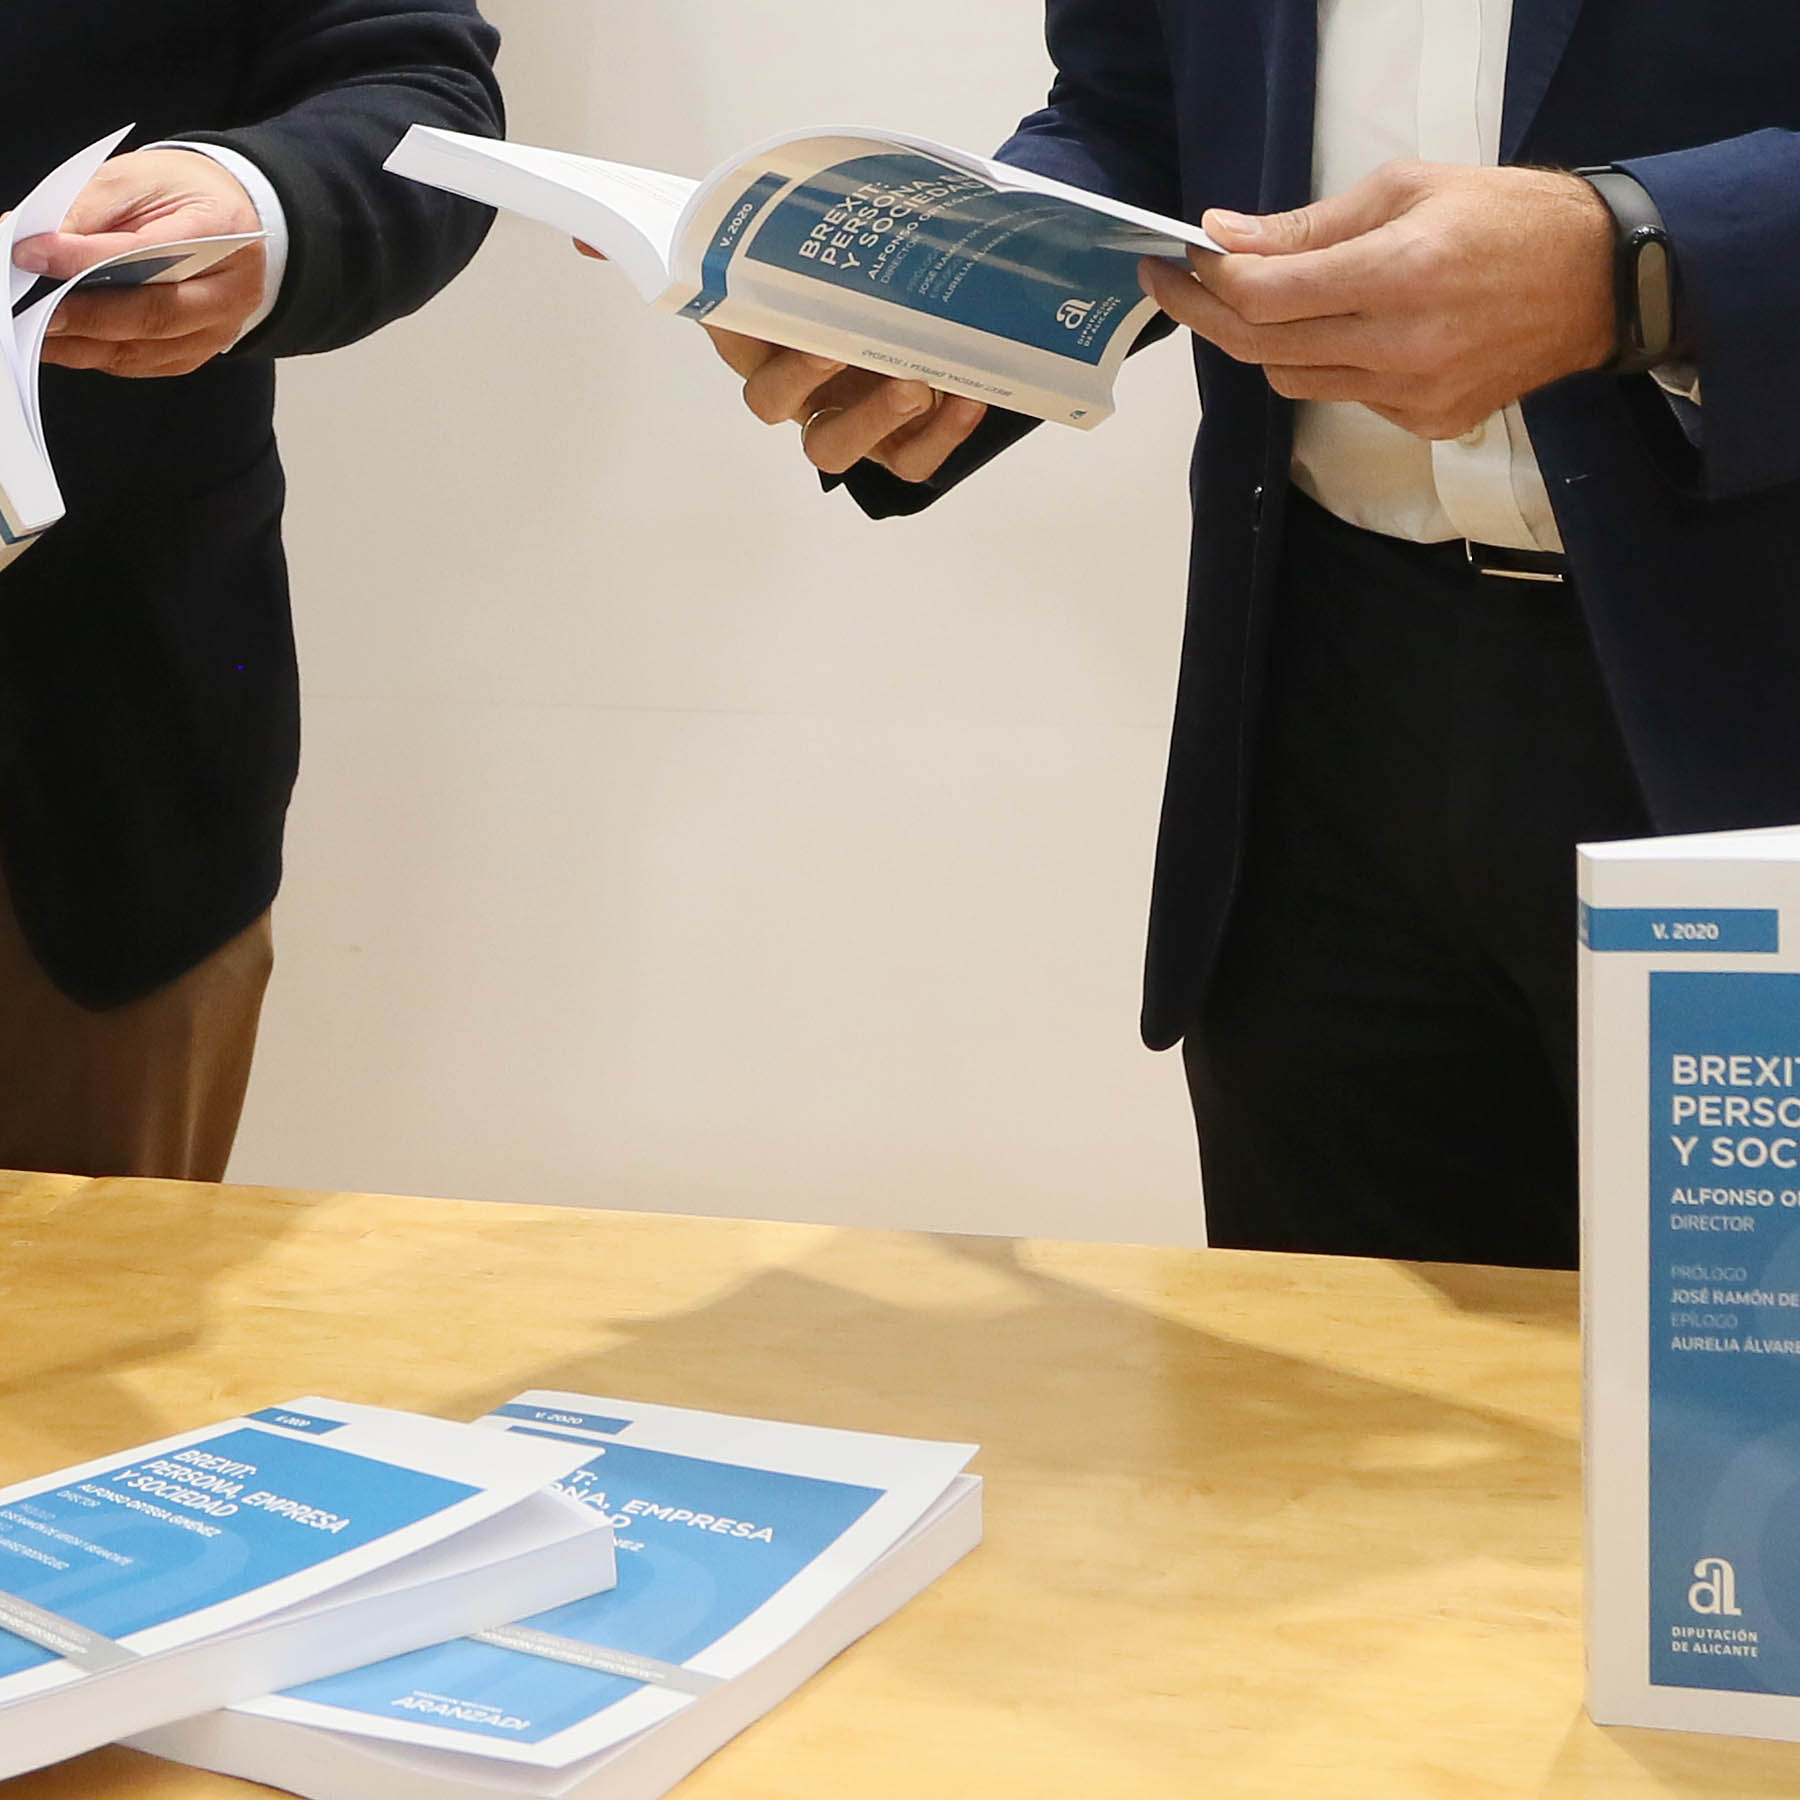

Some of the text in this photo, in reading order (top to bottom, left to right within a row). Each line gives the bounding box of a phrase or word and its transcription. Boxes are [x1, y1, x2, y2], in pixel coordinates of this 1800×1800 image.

[719, 202, 753, 247] V. 2020
[798, 180, 890, 259] BREXIT:
[819, 179, 943, 267] PERSONA,
[840, 251, 863, 271] Y
[858, 181, 985, 249] SOCIEDAD
[868, 221, 919, 280] ALFONSO
[1651, 923, 1720, 941] V. 2020
[1670, 1135, 1699, 1167] Y
[1670, 1187, 1775, 1207] ALFONSO
[1670, 1214, 1755, 1232] DIRECTOR
[1671, 1264, 1748, 1282] PRÓLOGO
[1670, 1287, 1711, 1305] JOSÉ
[1712, 1289, 1776, 1307] RAMÓN
[1778, 1292, 1800, 1308] DE
[1671, 1311, 1739, 1329] EPÍLOGO
[1670, 1335, 1741, 1353] AURELIA
[547, 1412, 583, 1425] 2020
[172, 1449, 258, 1480] BREXIT:
[111, 1469, 240, 1518] Y SOCIEDAD
[141, 1460, 351, 1535] PERSONA, EMPRESA
[621, 1498, 775, 1543] EMPRESA
[1671, 1625, 1759, 1643] DIPUTACIÓN
[1671, 1641, 1759, 1658] DE ALICANTE
[391, 1696, 532, 1731] ARANZADI
